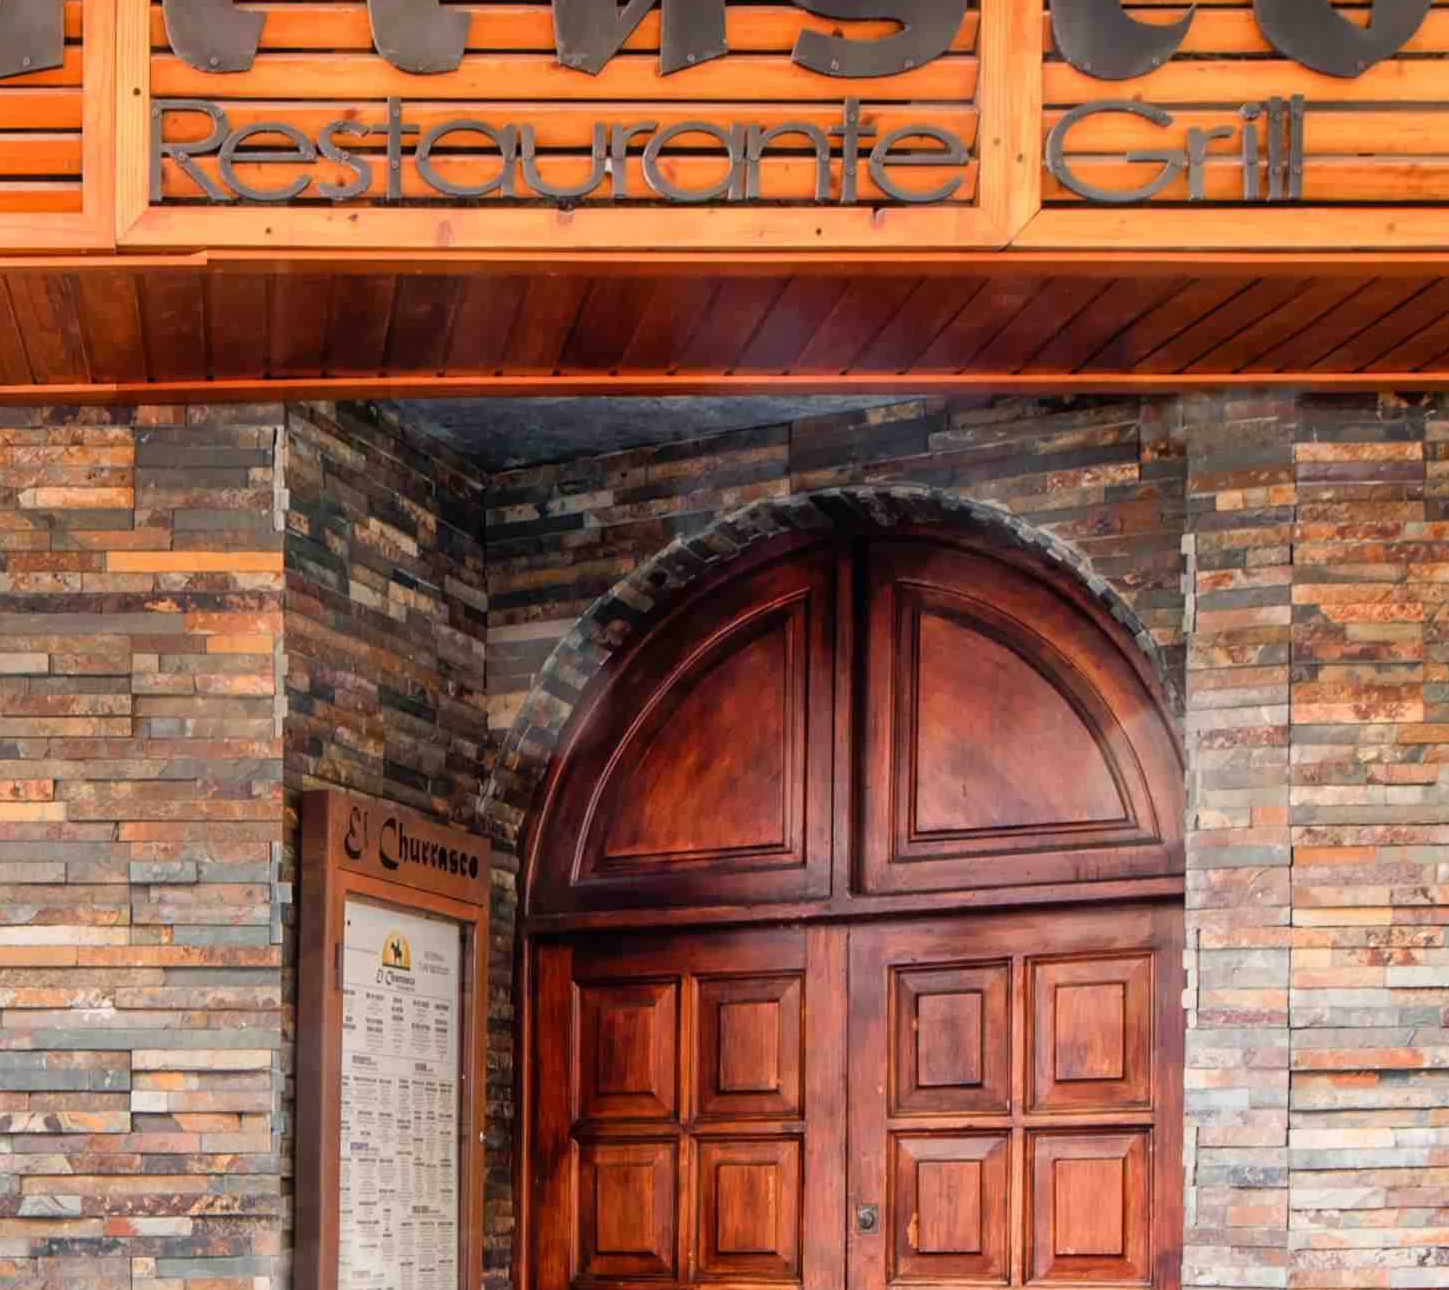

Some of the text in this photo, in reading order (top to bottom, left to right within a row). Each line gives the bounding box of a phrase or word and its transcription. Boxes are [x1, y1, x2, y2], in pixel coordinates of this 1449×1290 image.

[148, 94, 1305, 208] Restaurante Grill
[343, 806, 480, 880] El Churrasco
